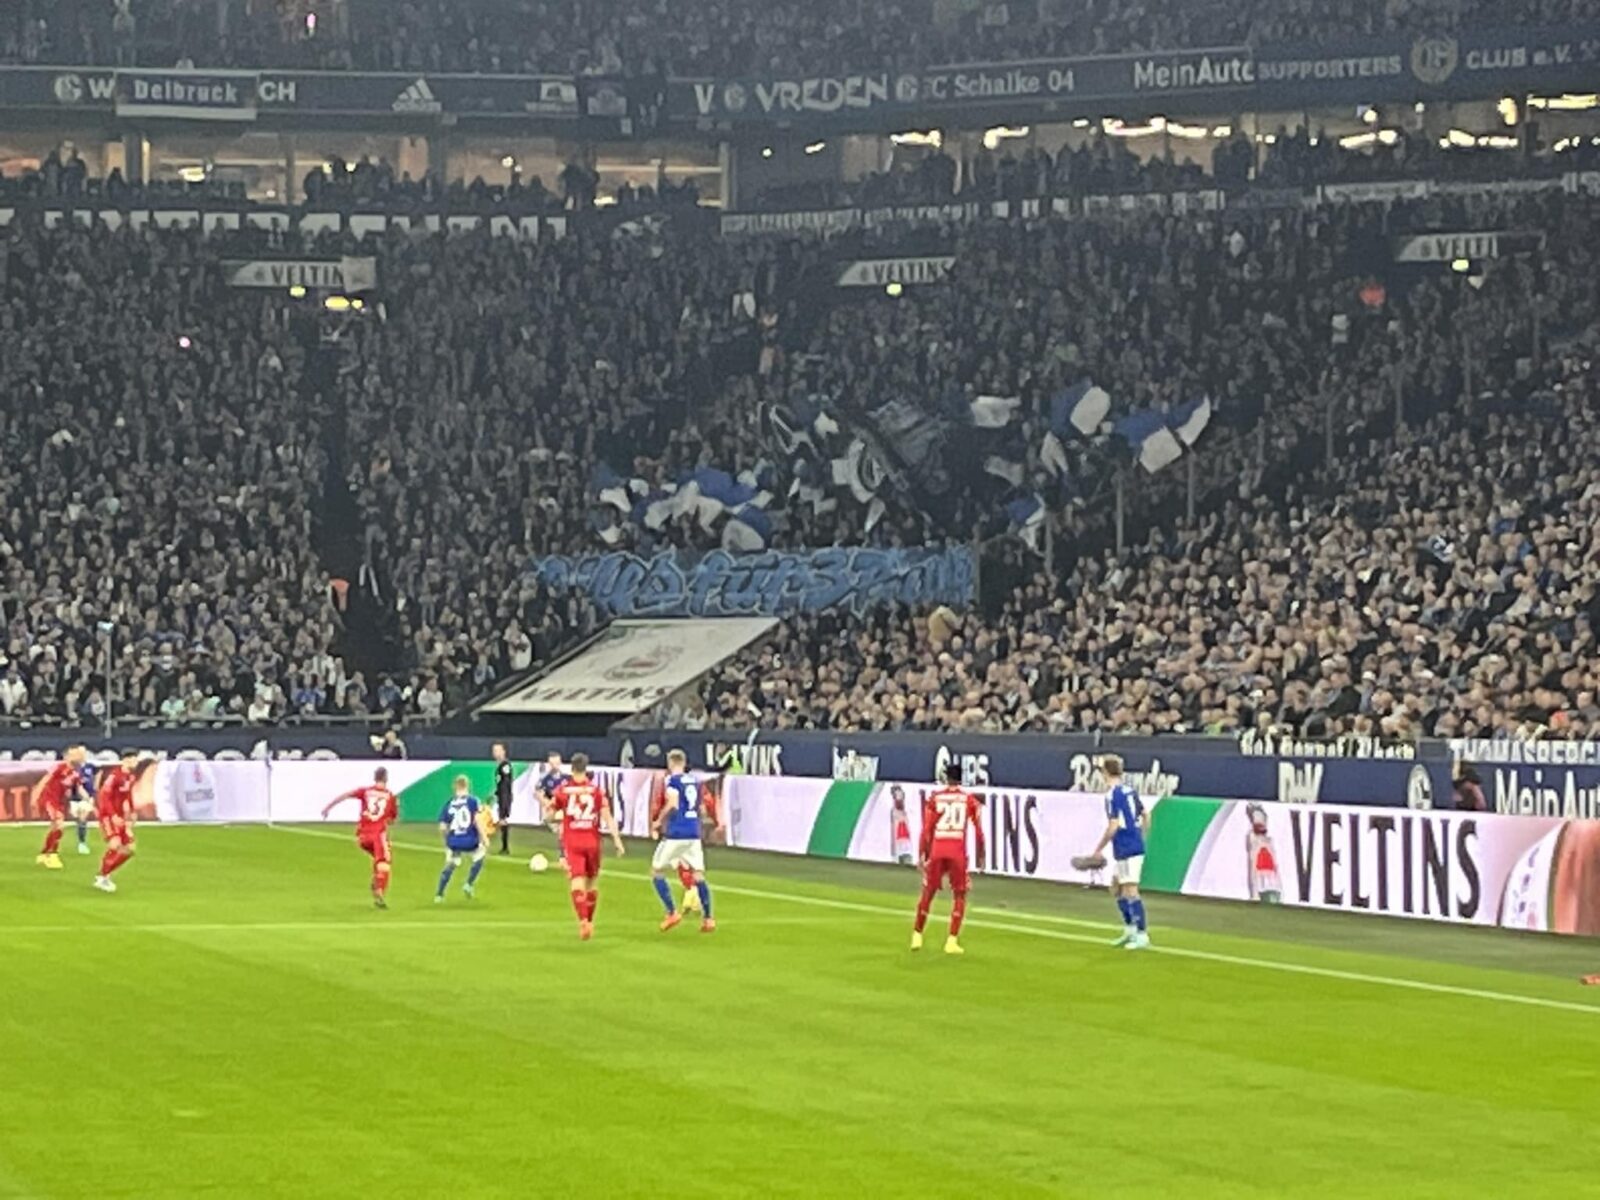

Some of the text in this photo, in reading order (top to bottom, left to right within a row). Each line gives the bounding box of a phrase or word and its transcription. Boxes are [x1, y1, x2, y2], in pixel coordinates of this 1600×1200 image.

[1258, 54, 1402, 82] SUPPORTERS
[1466, 47, 1527, 70] CLUB
[755, 73, 889, 113] VREDEN
[954, 71, 1040, 97] Schalke
[1048, 68, 1074, 92] 04
[565, 794, 596, 821] 42
[684, 785, 698, 811] 9
[935, 799, 967, 831] 20
[1289, 809, 1481, 918] VELTINS
